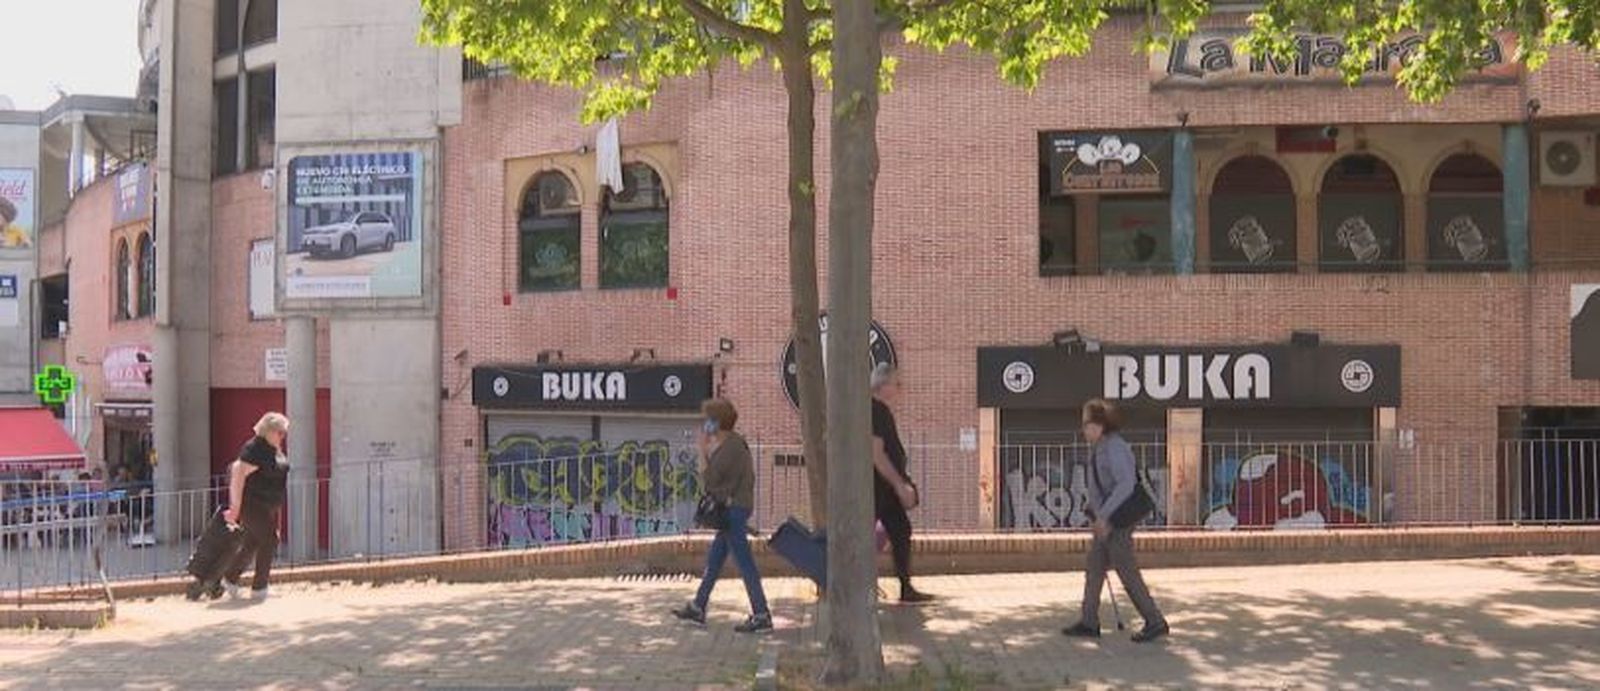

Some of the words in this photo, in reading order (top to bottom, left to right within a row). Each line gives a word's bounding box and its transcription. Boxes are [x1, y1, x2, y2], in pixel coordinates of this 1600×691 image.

[1167, 31, 1235, 78] La
[296, 166, 331, 176] NUEVO
[542, 371, 626, 400] BUKA
[1104, 353, 1271, 400] BUKA
